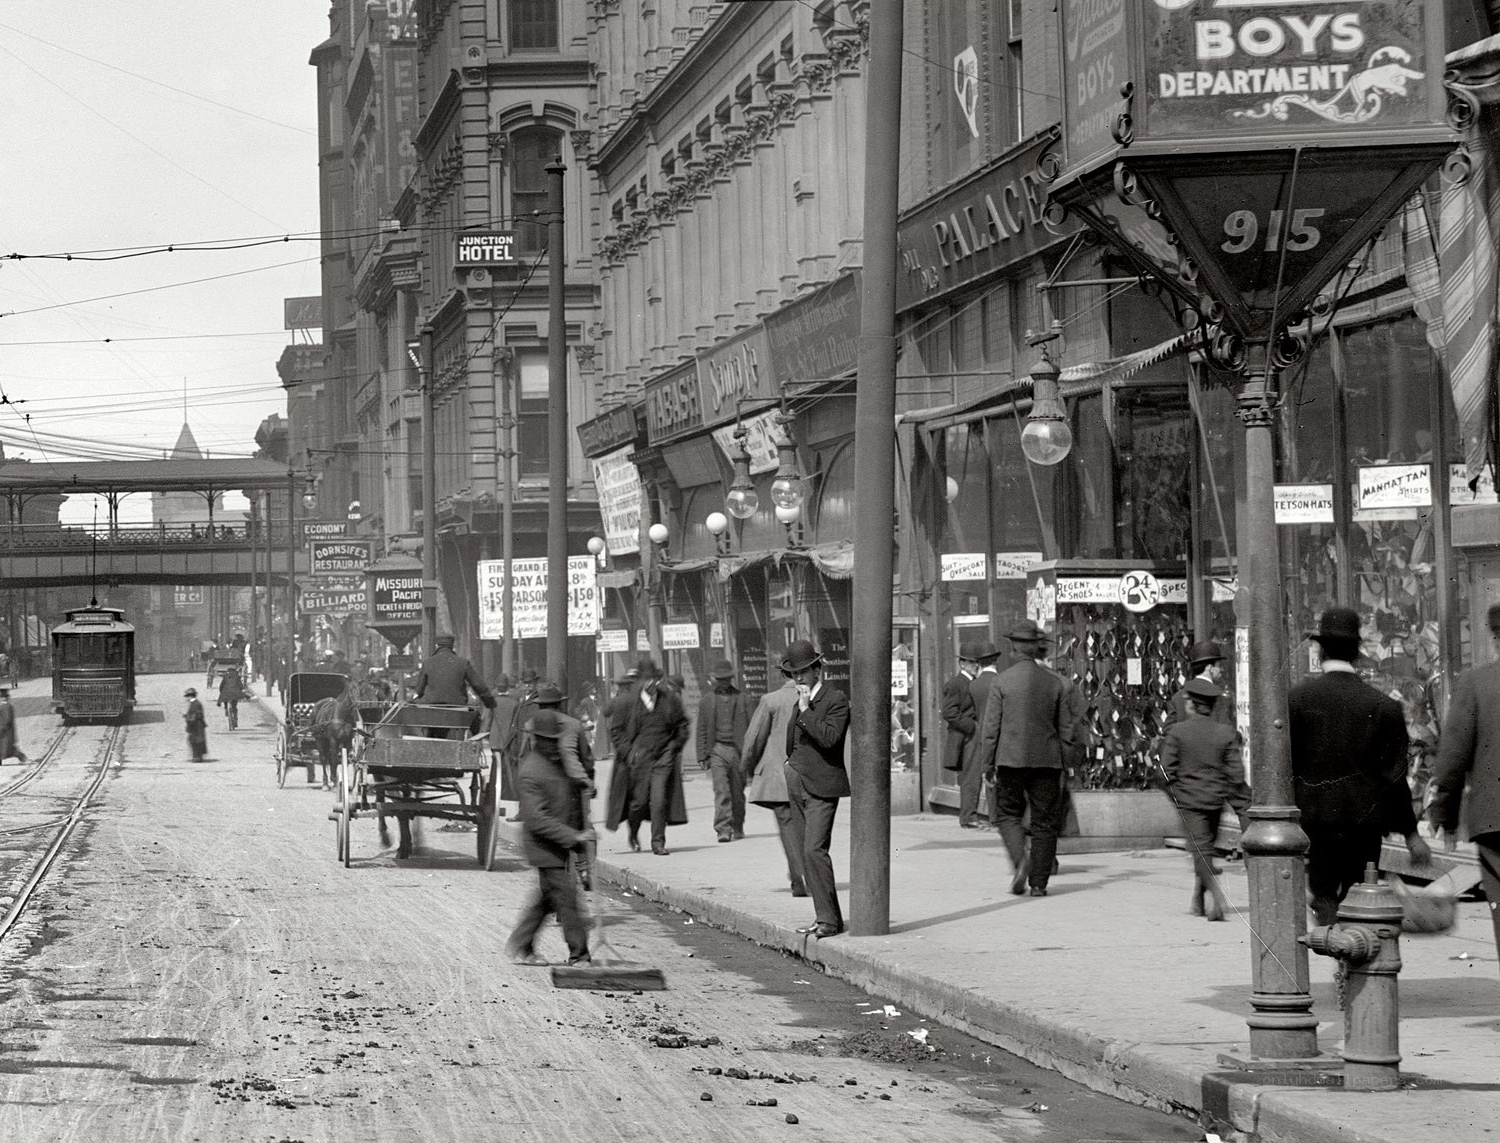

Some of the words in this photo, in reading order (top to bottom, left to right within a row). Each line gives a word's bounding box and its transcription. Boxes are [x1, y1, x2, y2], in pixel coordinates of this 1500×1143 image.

[1194, 12, 1366, 61] BOYS
[1077, 52, 1115, 106] BOYS
[1159, 63, 1351, 98] DEPARTMENT
[932, 170, 1046, 268] PALACE
[1221, 208, 1326, 254] 915
[460, 236, 514, 246] JUNCTION
[460, 245, 514, 262] HOTEL
[644, 370, 702, 440] WABASH
[1361, 468, 1428, 499] MANHATTAN
[1273, 500, 1309, 511] TETSON
[1310, 499, 1332, 510] HATS
[304, 523, 346, 534] ECONOMY
[315, 544, 368, 559] DORNSIFE'S
[513, 563, 539, 572] GRAND
[949, 560, 985, 579] OVERCOAT
[375, 577, 423, 592] MISSOURI
[489, 576, 533, 589] SUDAY
[1057, 582, 1090, 597] REGENT
[392, 589, 423, 603] PACIFI
[1068, 590, 1093, 601] SHOES
[376, 602, 398, 611] TICKET
[385, 611, 417, 619] OFFICE
[664, 640, 699, 648] INDIANAPOLIS
[832, 643, 846, 652] The
